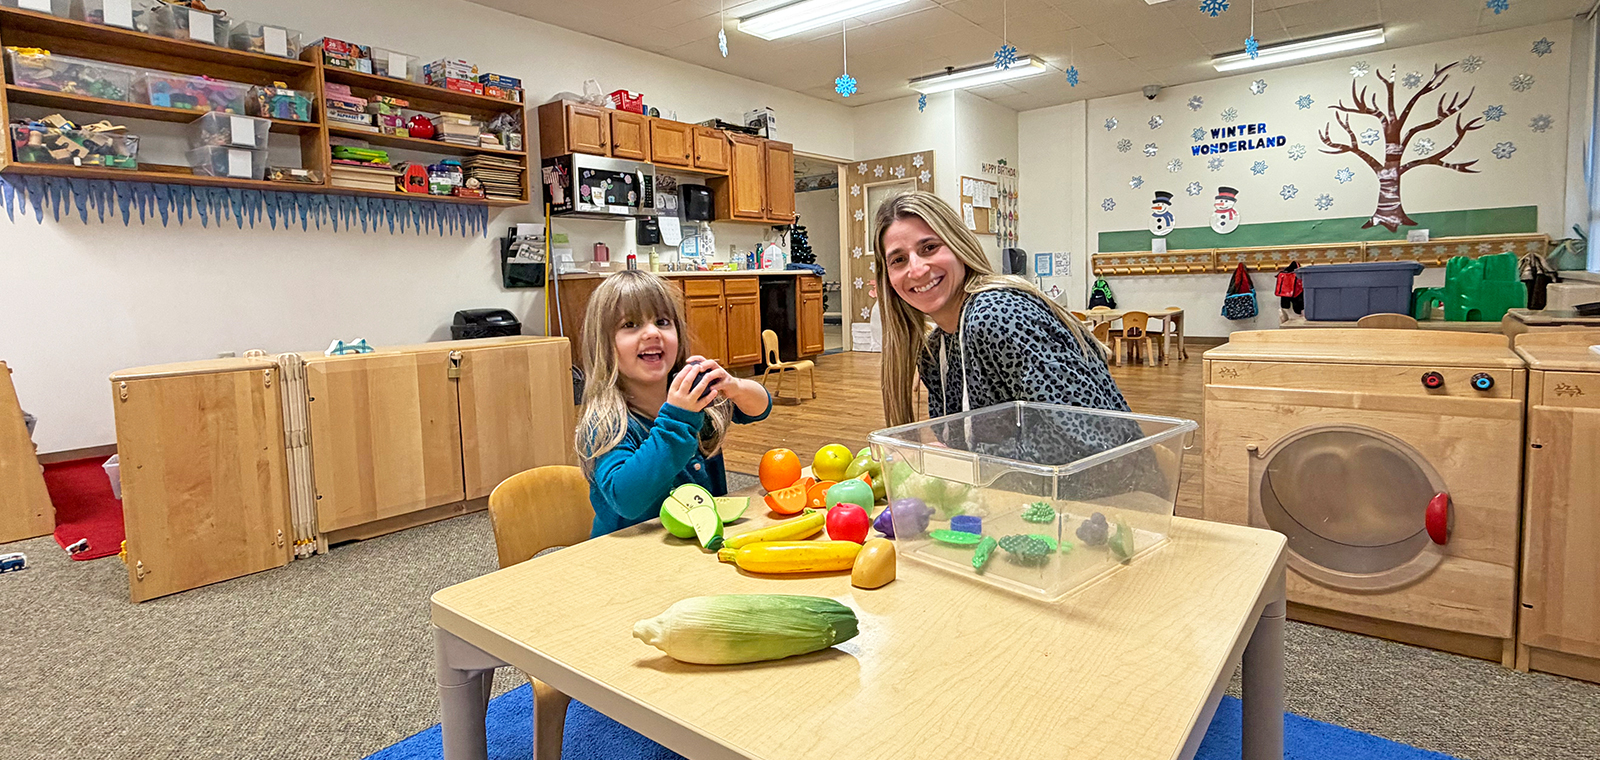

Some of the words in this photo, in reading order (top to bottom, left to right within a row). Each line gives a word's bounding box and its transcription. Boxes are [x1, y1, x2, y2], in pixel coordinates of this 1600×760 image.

[1210, 123, 1267, 139] WINTER
[1191, 135, 1287, 156] WONDERLAND
[981, 162, 997, 174] HAPPY
[997, 165, 1017, 177] BIRTHDA
[694, 495, 703, 504] 3
